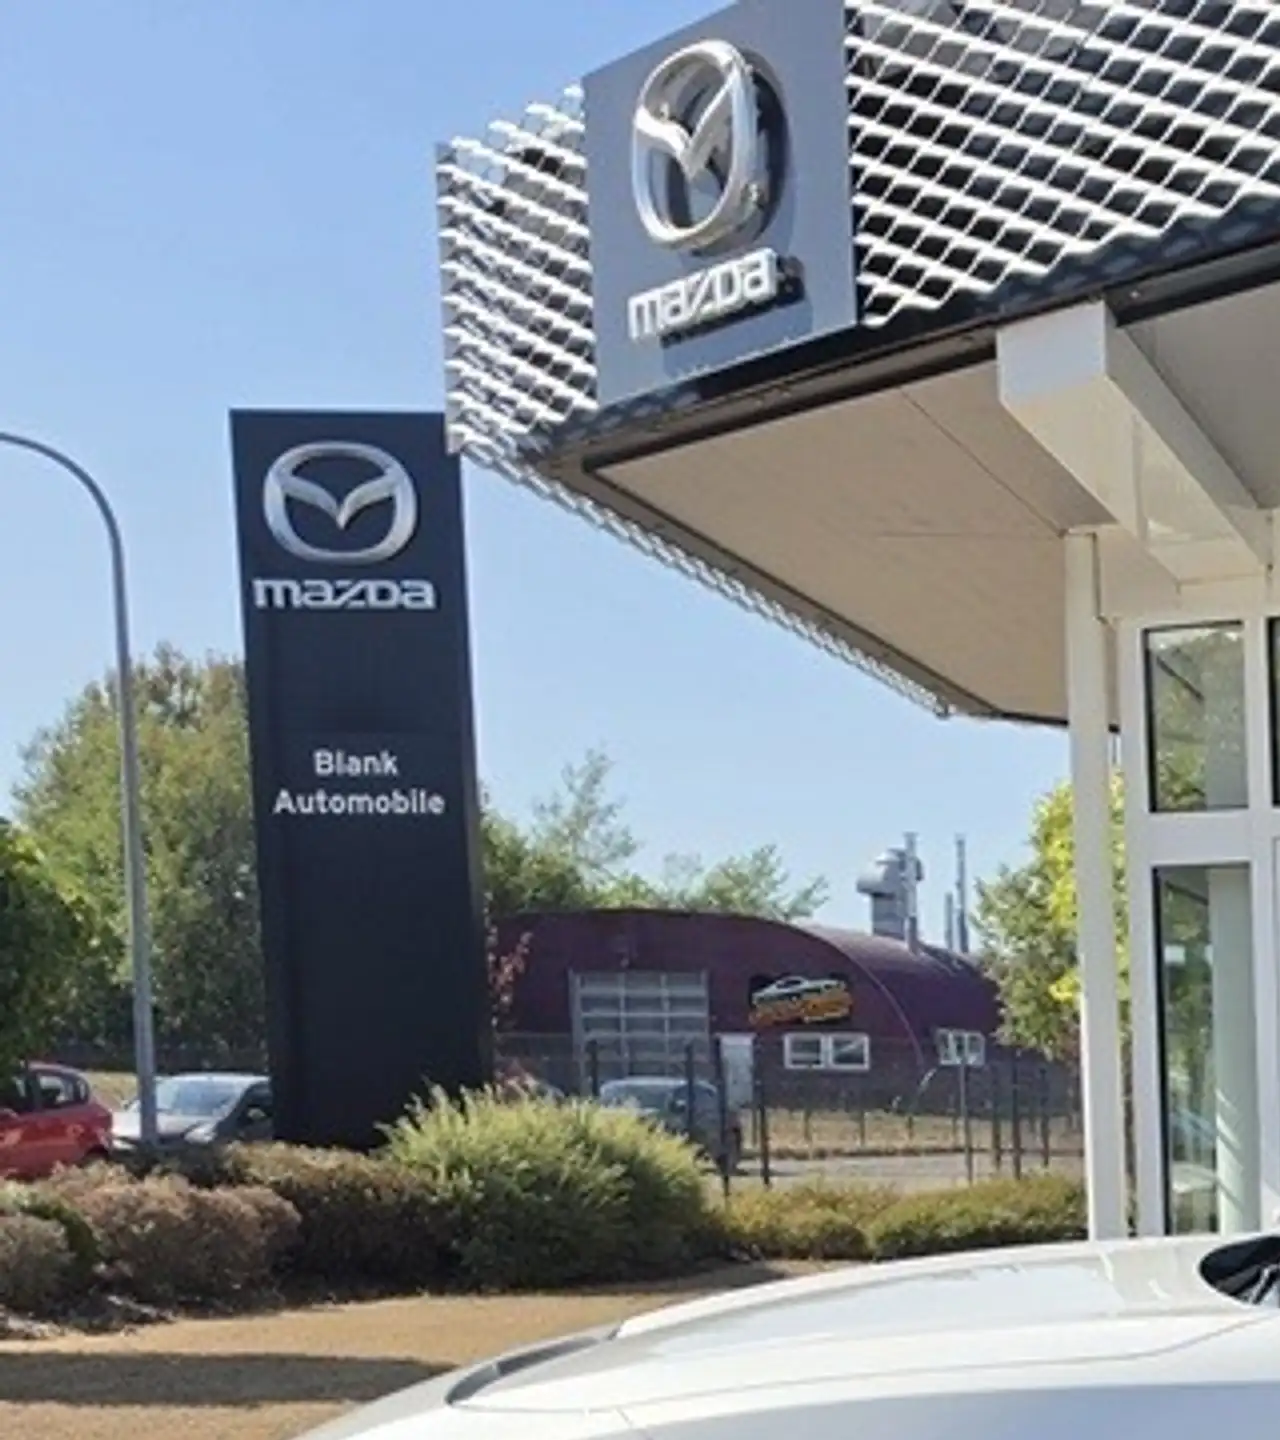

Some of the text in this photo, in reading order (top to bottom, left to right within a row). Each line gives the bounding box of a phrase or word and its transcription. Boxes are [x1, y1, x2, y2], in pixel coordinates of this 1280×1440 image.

[628, 248, 778, 340] mazda
[252, 579, 438, 609] mazda
[313, 750, 398, 776] Blank
[272, 788, 446, 814] Automobile
